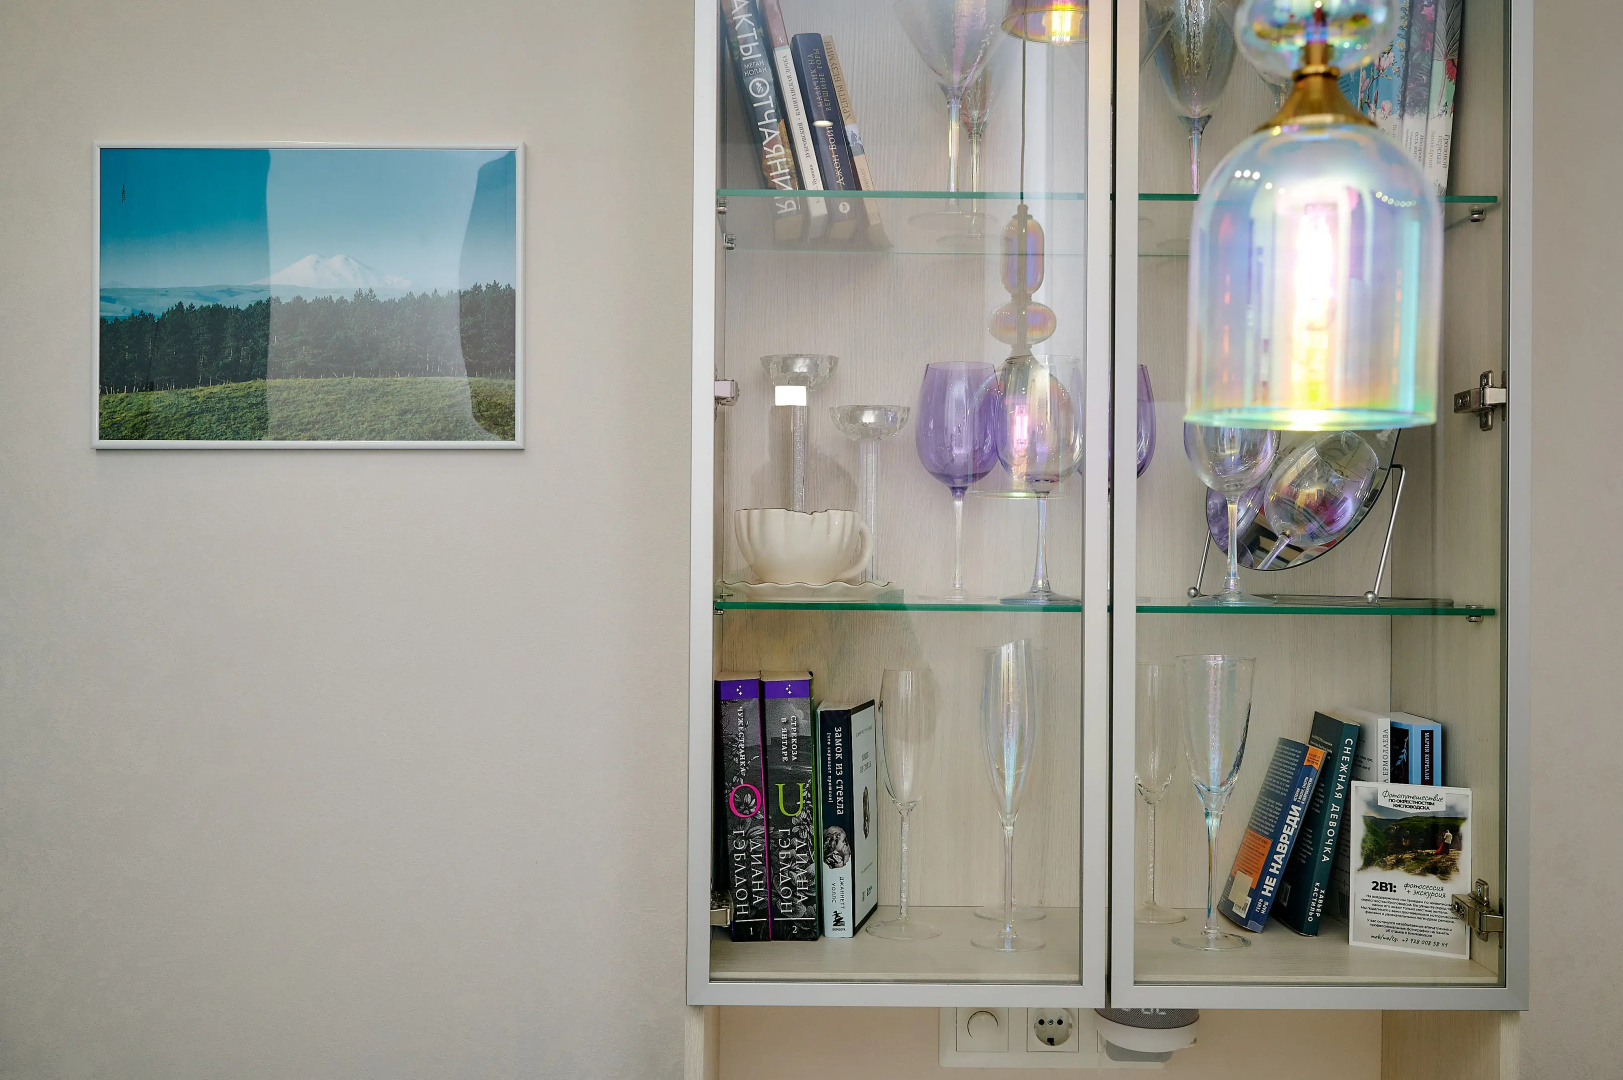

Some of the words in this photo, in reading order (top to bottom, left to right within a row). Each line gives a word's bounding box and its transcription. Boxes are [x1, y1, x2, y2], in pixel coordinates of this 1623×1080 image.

[731, 0, 761, 60] АКТЫ
[744, 60, 765, 69] МЕГАН
[744, 67, 768, 77] НОЛАН
[808, 53, 815, 65] НА
[813, 48, 823, 69] ГОРЫ
[825, 40, 841, 83] БЕЗУМИЯ
[811, 68, 823, 107] МАЛЬЧИК
[819, 73, 832, 111] ВЕРШИНЕ
[836, 84, 852, 120] ХРЕБТЫ
[832, 154, 846, 186] ДЖОН
[1335, 738, 1354, 799] СНЕЖНАЯ
[1382, 790, 1444, 803] Фотопутешествие
[1393, 803, 1431, 811] КИСЛОВОДСКА
[1397, 798, 1435, 806] ОКРЕСТНОСТЯМ
[1268, 804, 1302, 875] НАВРЕДИ
[1321, 803, 1340, 862] ДЕВОЧКА
[732, 830, 750, 915] ГЭБЛДОН
[749, 838, 765, 905] ДИАНА
[778, 829, 793, 913] ГЭБЛДОН
[795, 839, 809, 904] ДИАНА
[1261, 875, 1277, 897] НЕ
[1403, 882, 1445, 892] фотосессия
[1307, 882, 1320, 922] КАСТИЛЬО
[1315, 889, 1326, 918] ХАВЬЕР
[1412, 889, 1447, 900] экскурсия
[749, 927, 754, 935] 1
[792, 925, 798, 934] 2
